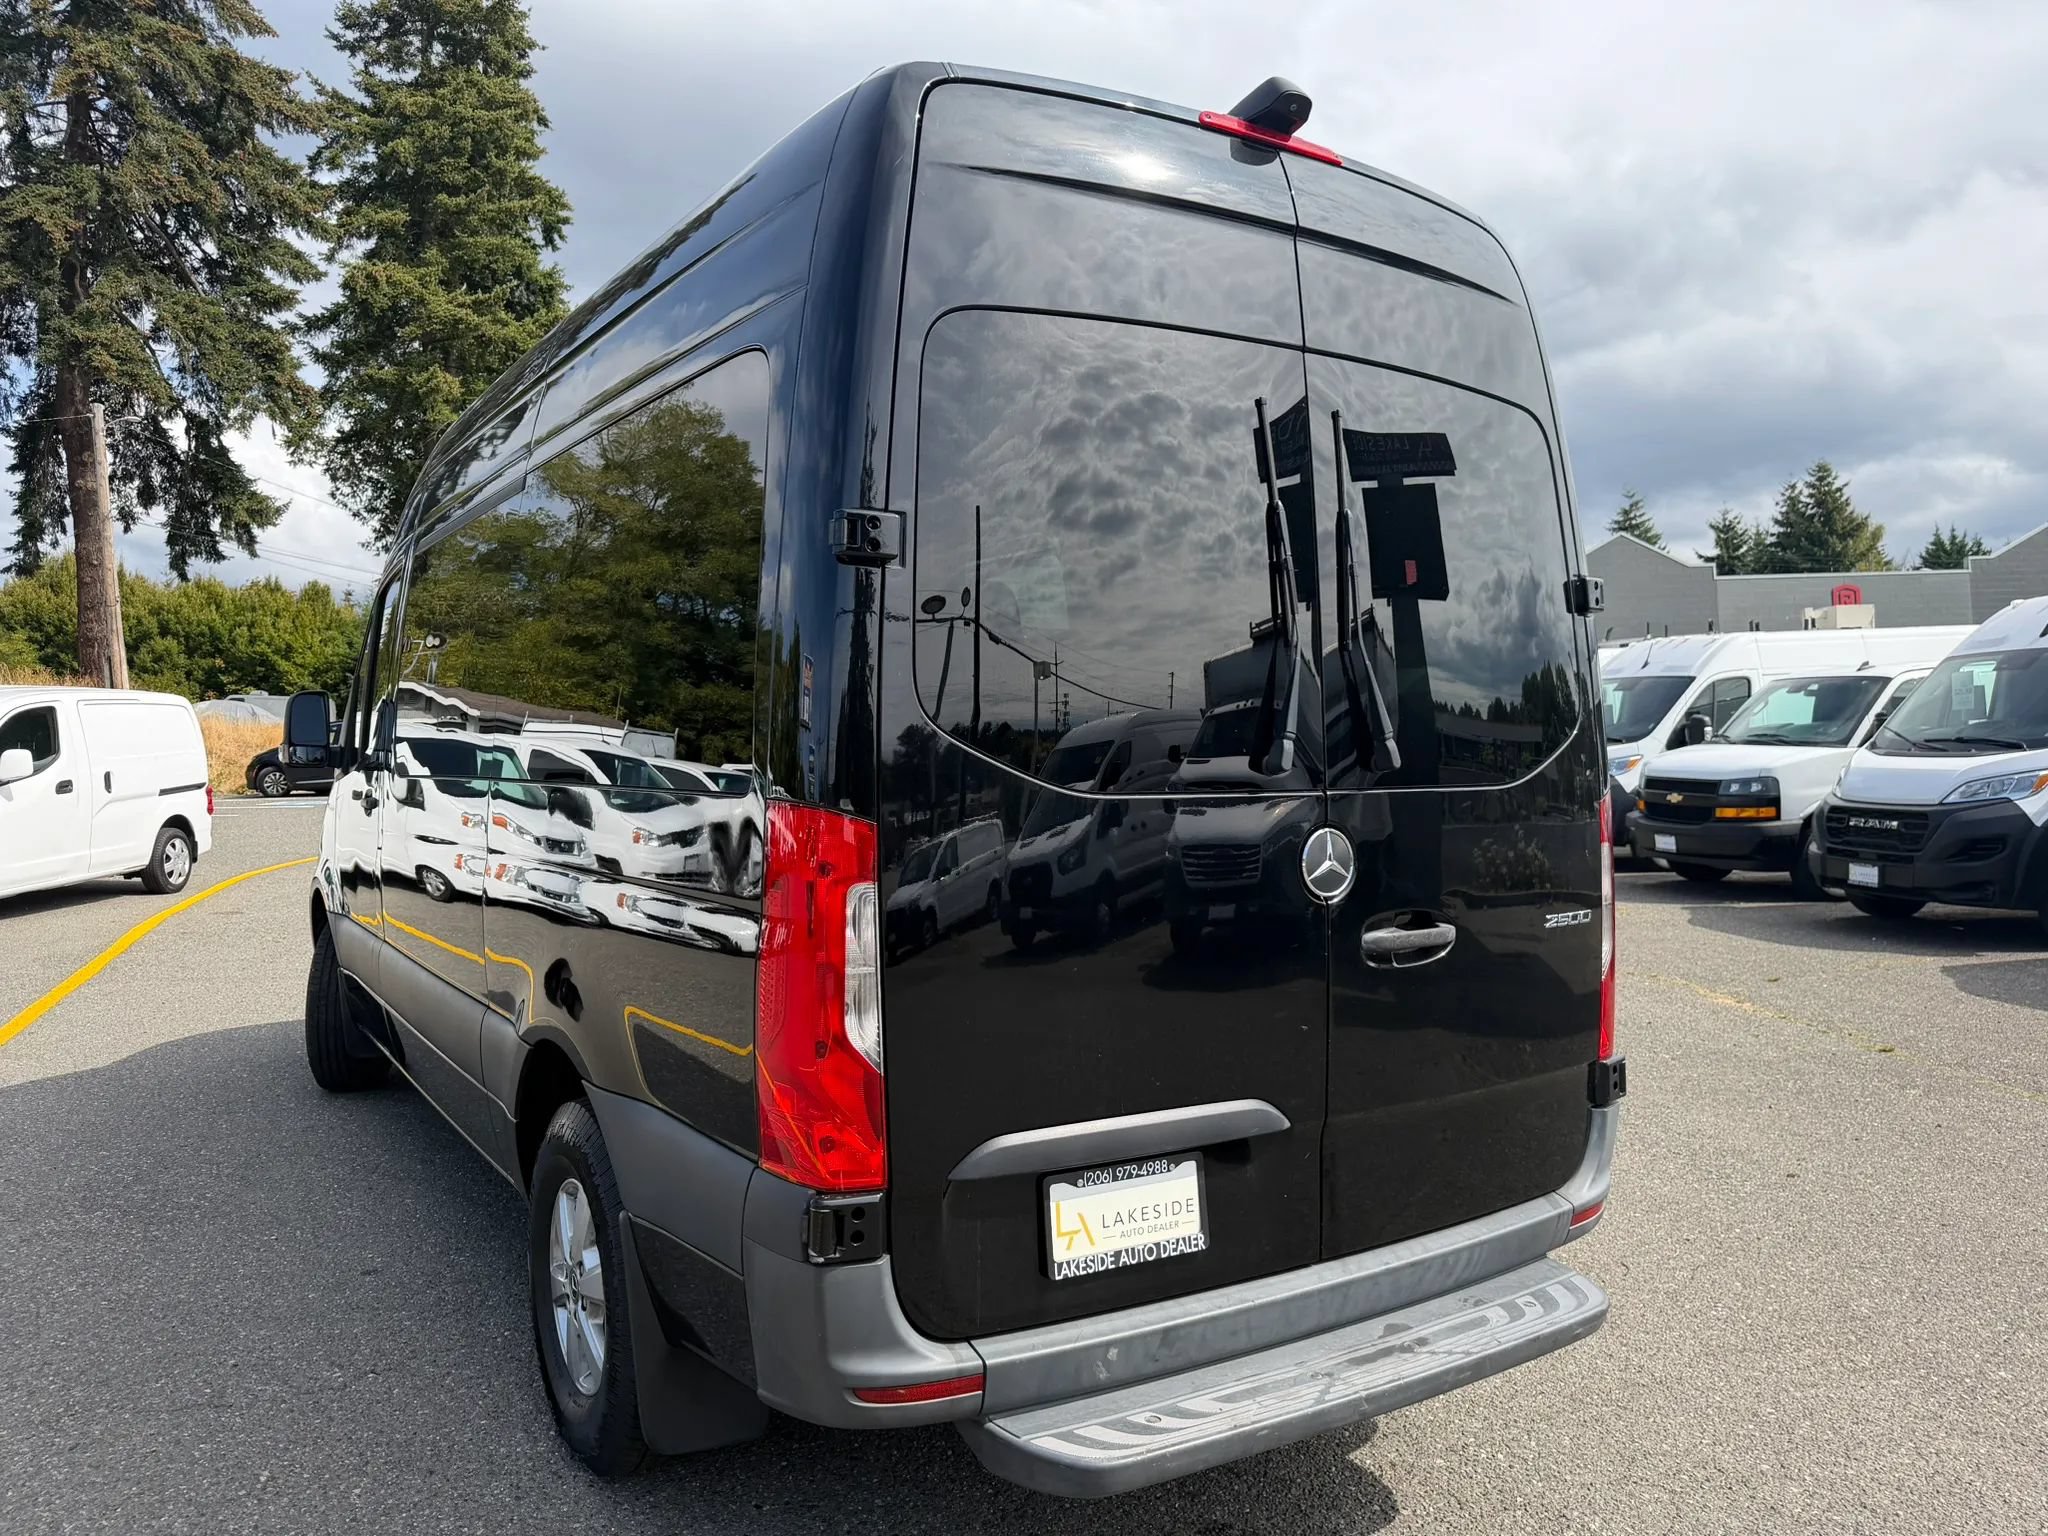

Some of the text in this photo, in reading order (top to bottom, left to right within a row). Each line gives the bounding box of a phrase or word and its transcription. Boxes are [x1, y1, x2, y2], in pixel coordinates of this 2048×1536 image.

[1849, 816, 1898, 829] RAM
[1544, 909, 1592, 928] 2500
[1083, 1160, 1168, 1187] (206) 979-4988
[1102, 1198, 1195, 1228] LAKESIDE
[1120, 1220, 1179, 1239] AUTO DEALER
[1054, 1233, 1206, 1280] LAKESIDE AUTO DEALER
